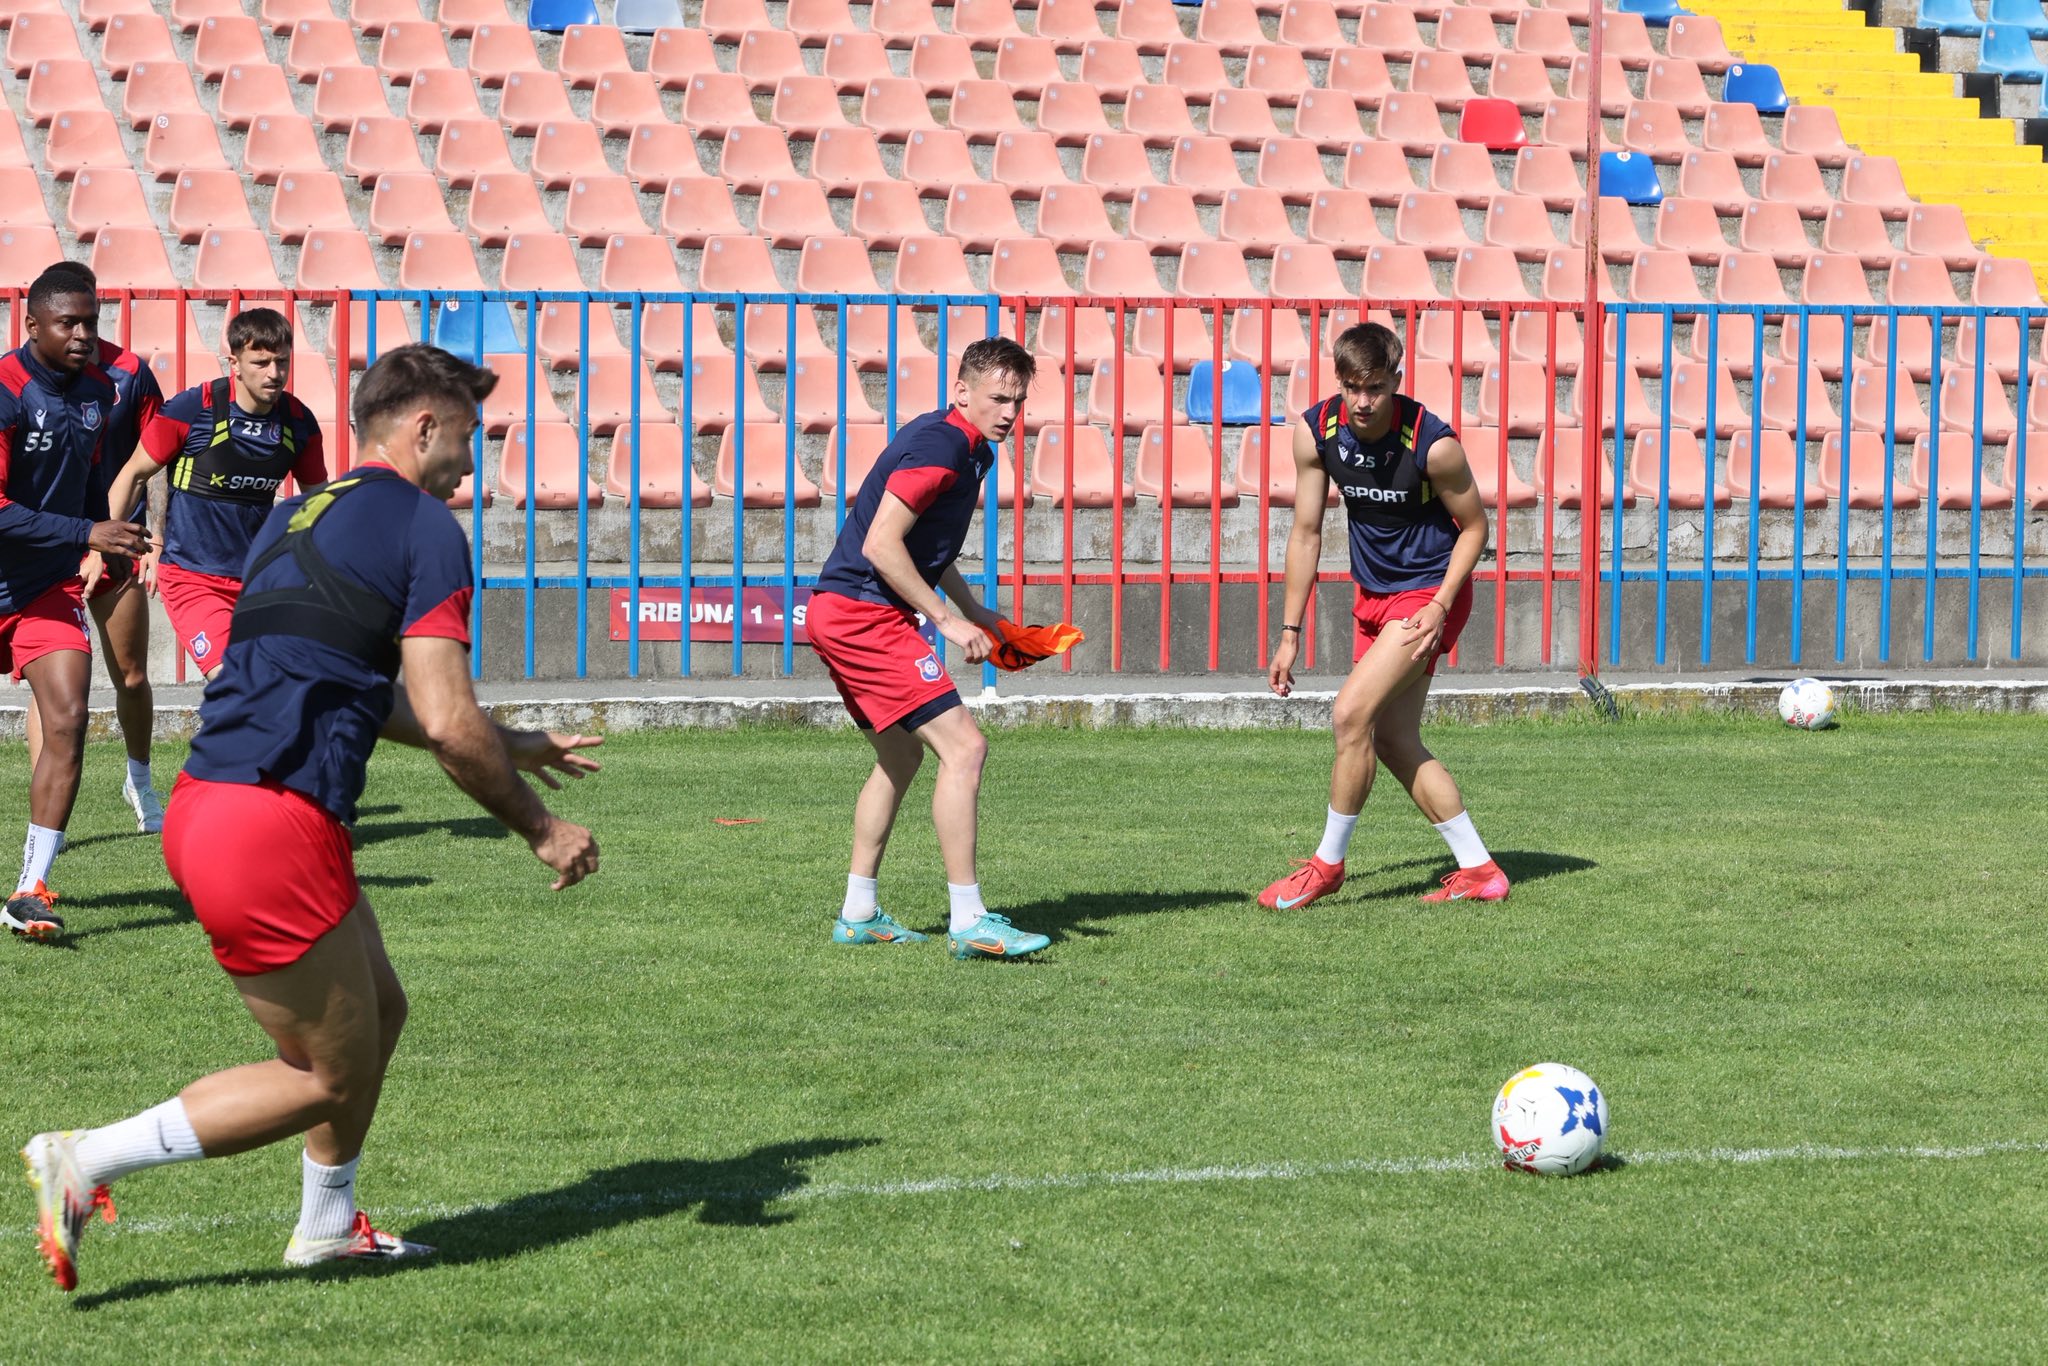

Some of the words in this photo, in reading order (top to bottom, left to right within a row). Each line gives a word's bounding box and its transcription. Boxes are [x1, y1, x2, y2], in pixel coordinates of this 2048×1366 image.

[241, 421, 263, 437] 23
[24, 431, 54, 452] 55
[1354, 453, 1376, 469] 25
[209, 472, 283, 491] K-SPOR
[751, 605, 763, 625] 1
